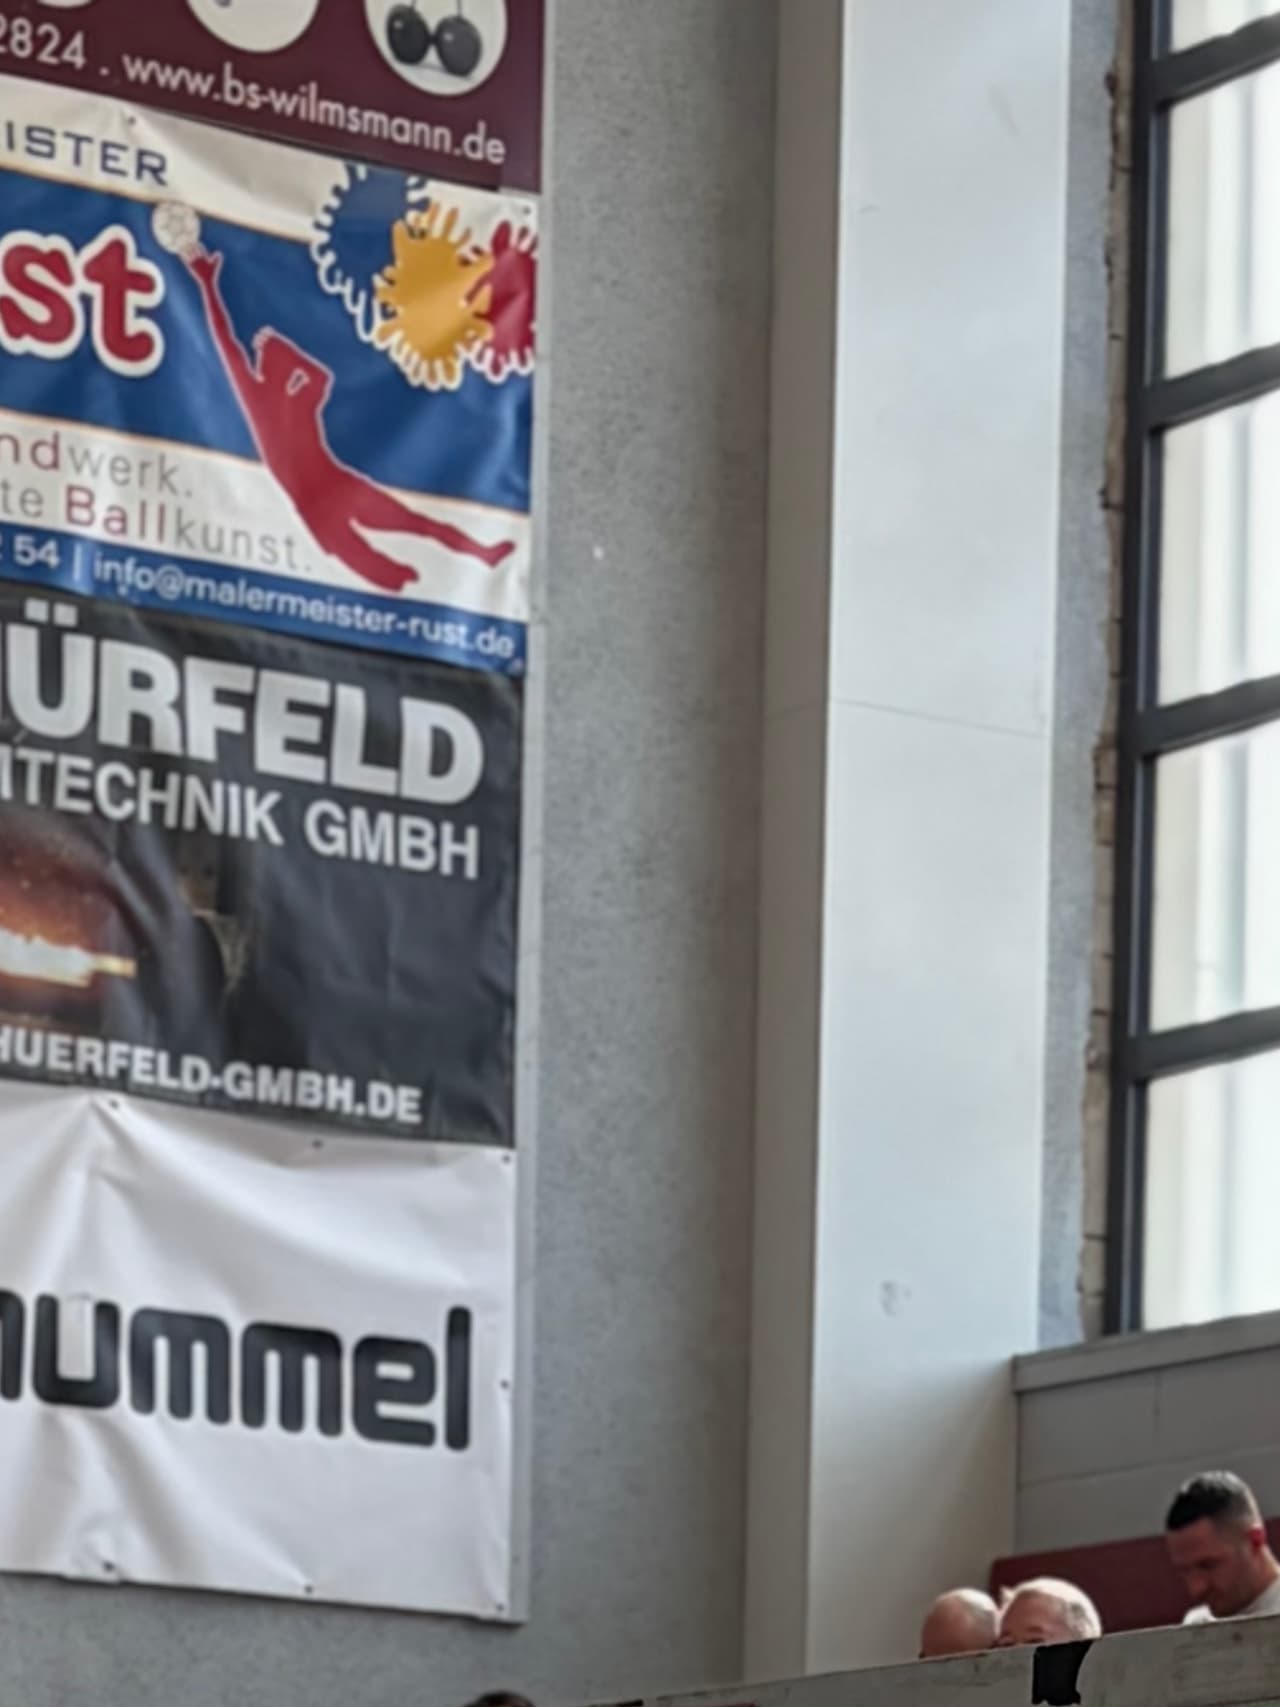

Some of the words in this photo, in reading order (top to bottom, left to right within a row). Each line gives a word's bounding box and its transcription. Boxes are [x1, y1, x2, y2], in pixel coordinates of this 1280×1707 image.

[122, 54, 507, 164] www.bs-wilmsmann.de
[64, 485, 313, 571] Ballkunst.
[13, 534, 61, 569] 54
[93, 557, 515, 659] info@malermeister-rust.de
[304, 800, 481, 881] GMBH
